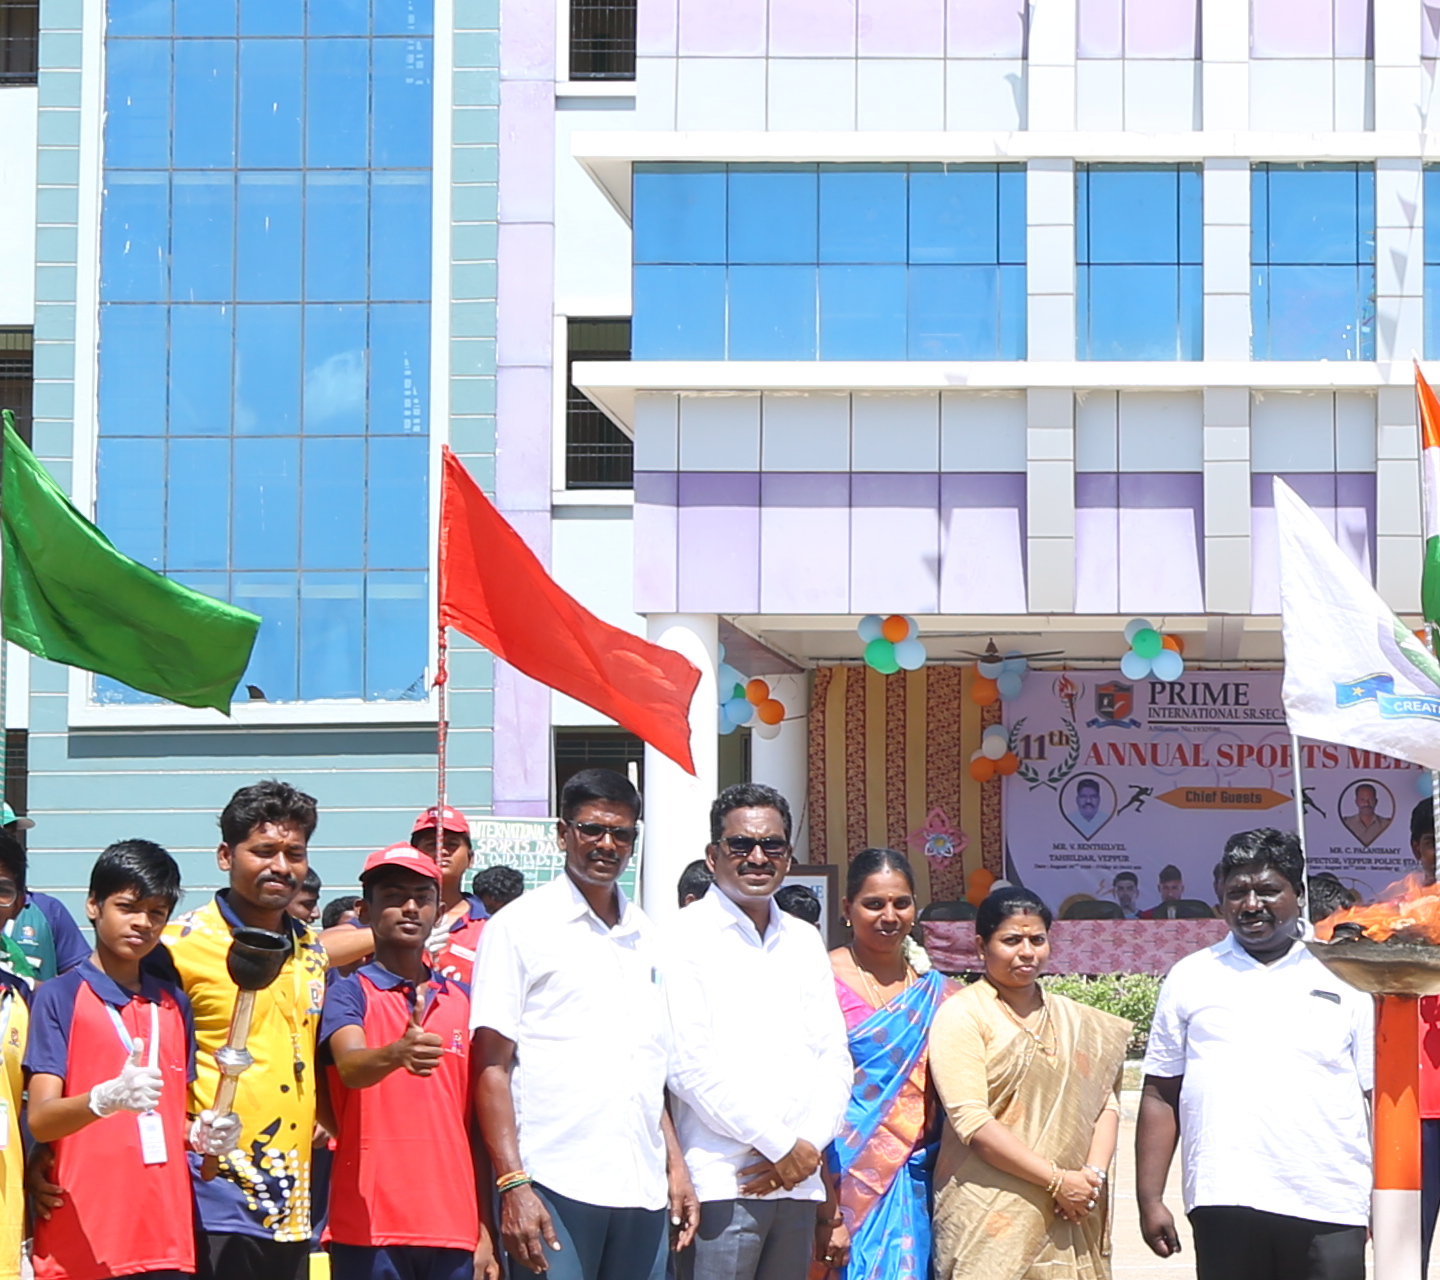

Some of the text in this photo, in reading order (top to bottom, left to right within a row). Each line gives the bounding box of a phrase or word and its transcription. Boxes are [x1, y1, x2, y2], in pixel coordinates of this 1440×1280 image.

[1148, 681, 1250, 706] PRIME
[1148, 706, 1241, 720] INTERNATIONAL
[1019, 729, 1072, 761] 11th
[1084, 742, 1210, 767] ANNUAL
[1185, 790, 1263, 804] Chief Guests
[477, 839, 531, 855] SPORTS
